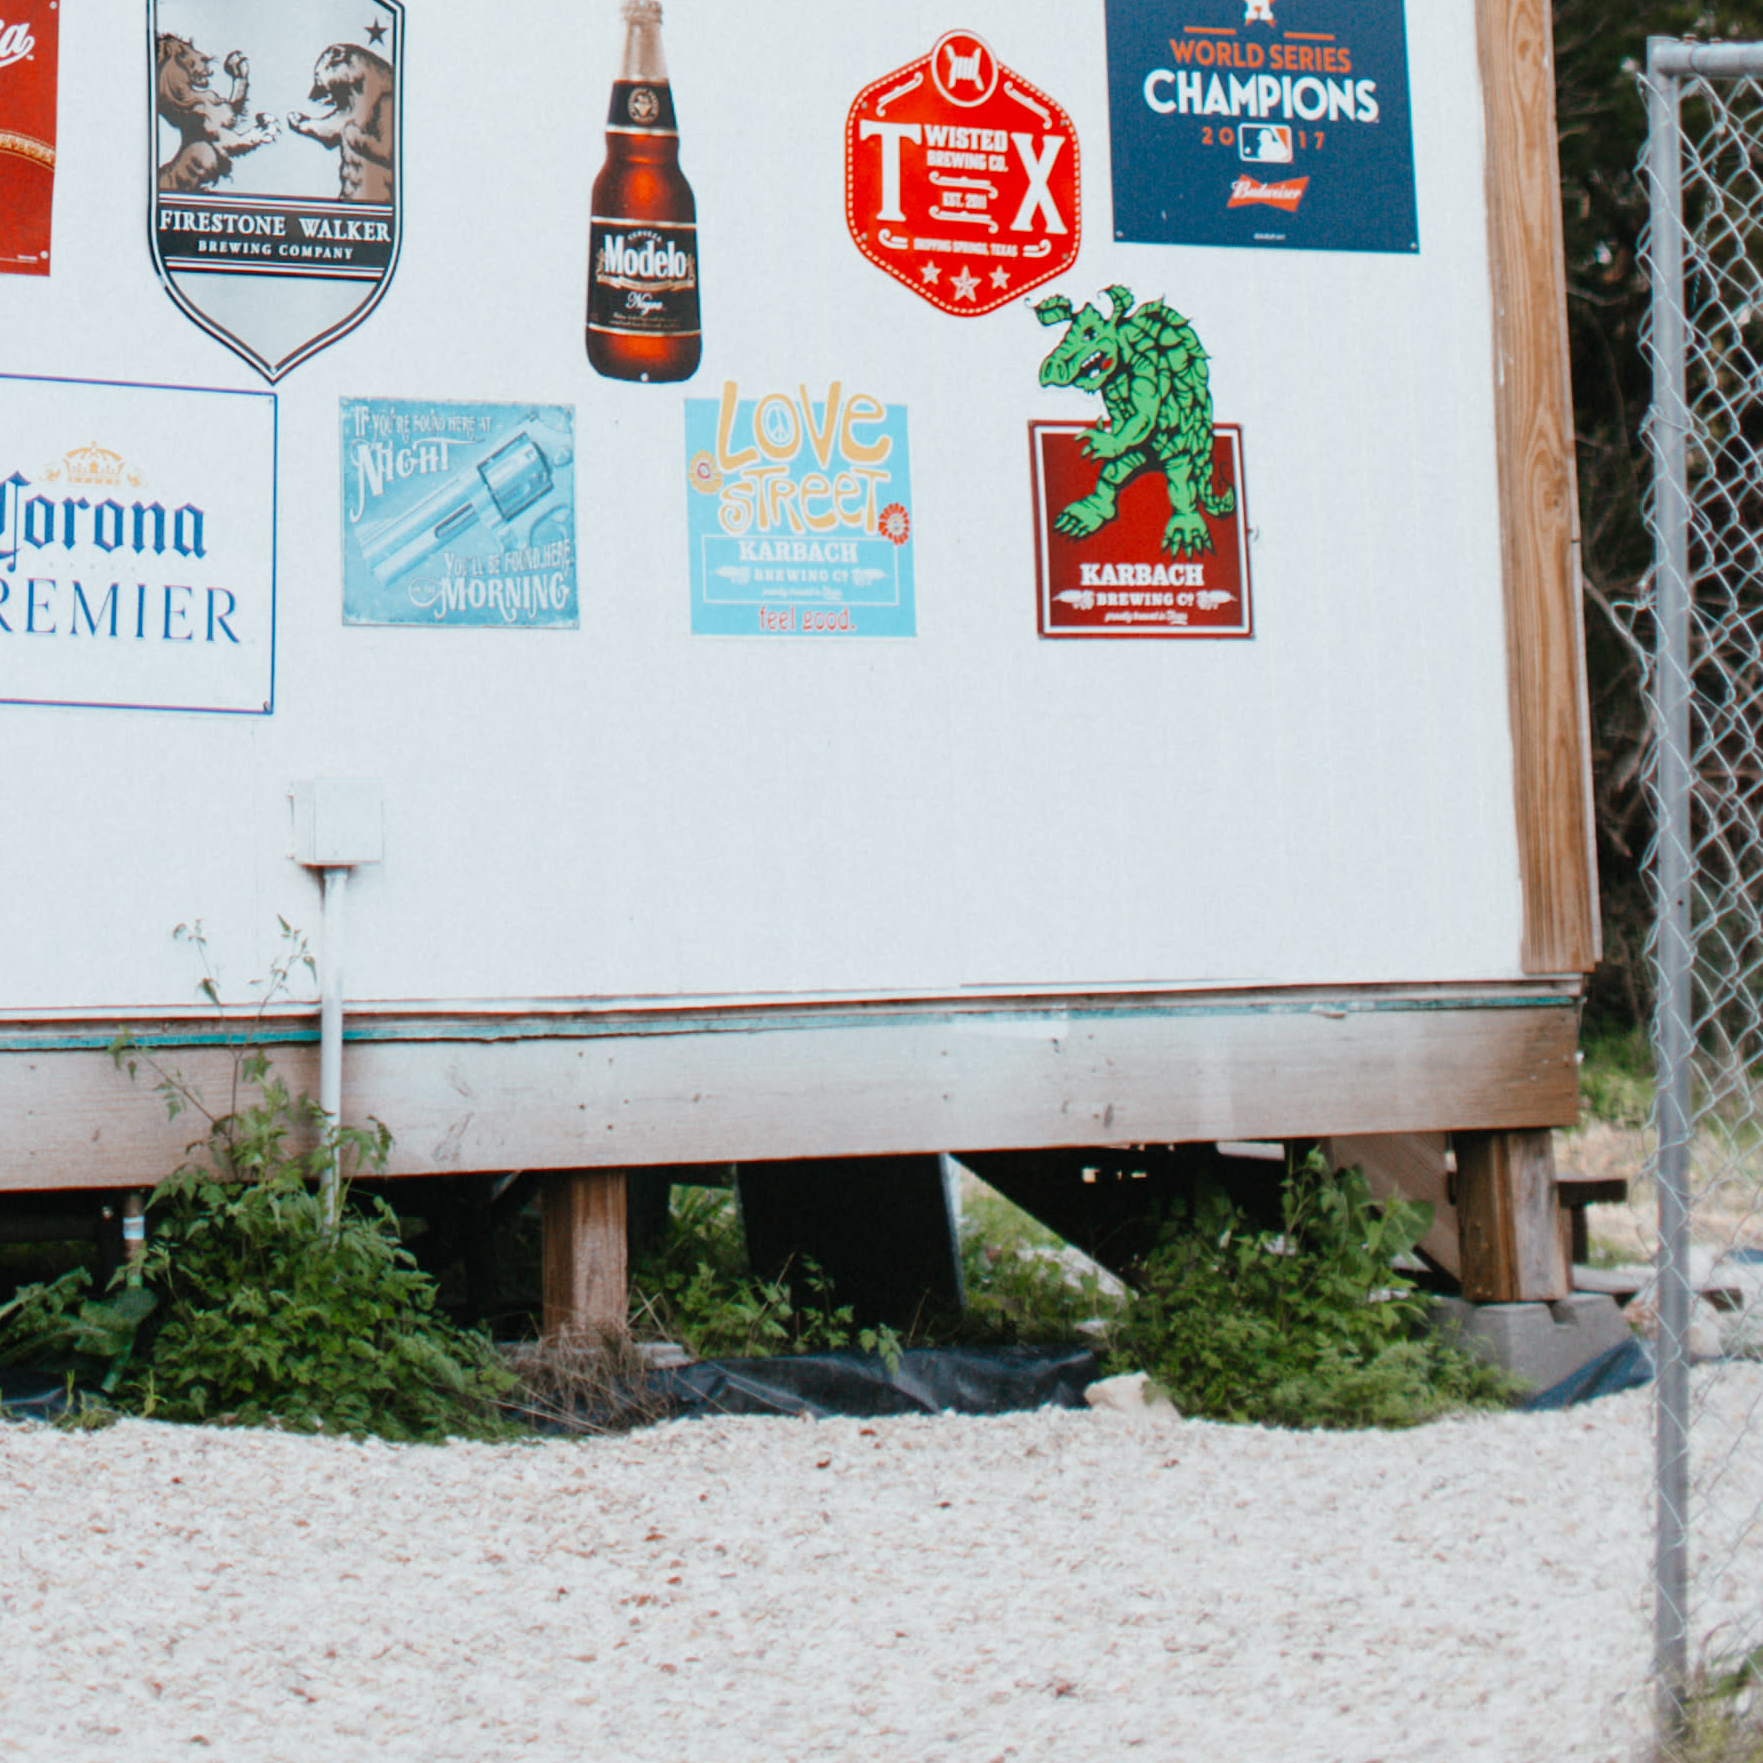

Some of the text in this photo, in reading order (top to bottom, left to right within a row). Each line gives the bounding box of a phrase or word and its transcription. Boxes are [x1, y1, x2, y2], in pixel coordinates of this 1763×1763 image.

[1169, 39, 1352, 73] WORLD SERIES
[1143, 69, 1379, 122] CHAMPIONS
[1230, 180, 1302, 200] Budweiser
[159, 210, 392, 242] FIRESTONE WALKER
[197, 240, 354, 260] BREWING COMPANY
[604, 234, 686, 279] Modelo
[355, 406, 369, 437] IF
[350, 437, 482, 523] NIGHT
[738, 541, 859, 564] KARBACH
[754, 568, 829, 582] BREWING
[1079, 563, 1205, 586] KARBACH
[434, 572, 570, 623] MORNING
[1096, 591, 1174, 606] BREWING
[760, 605, 856, 631] feel good.
